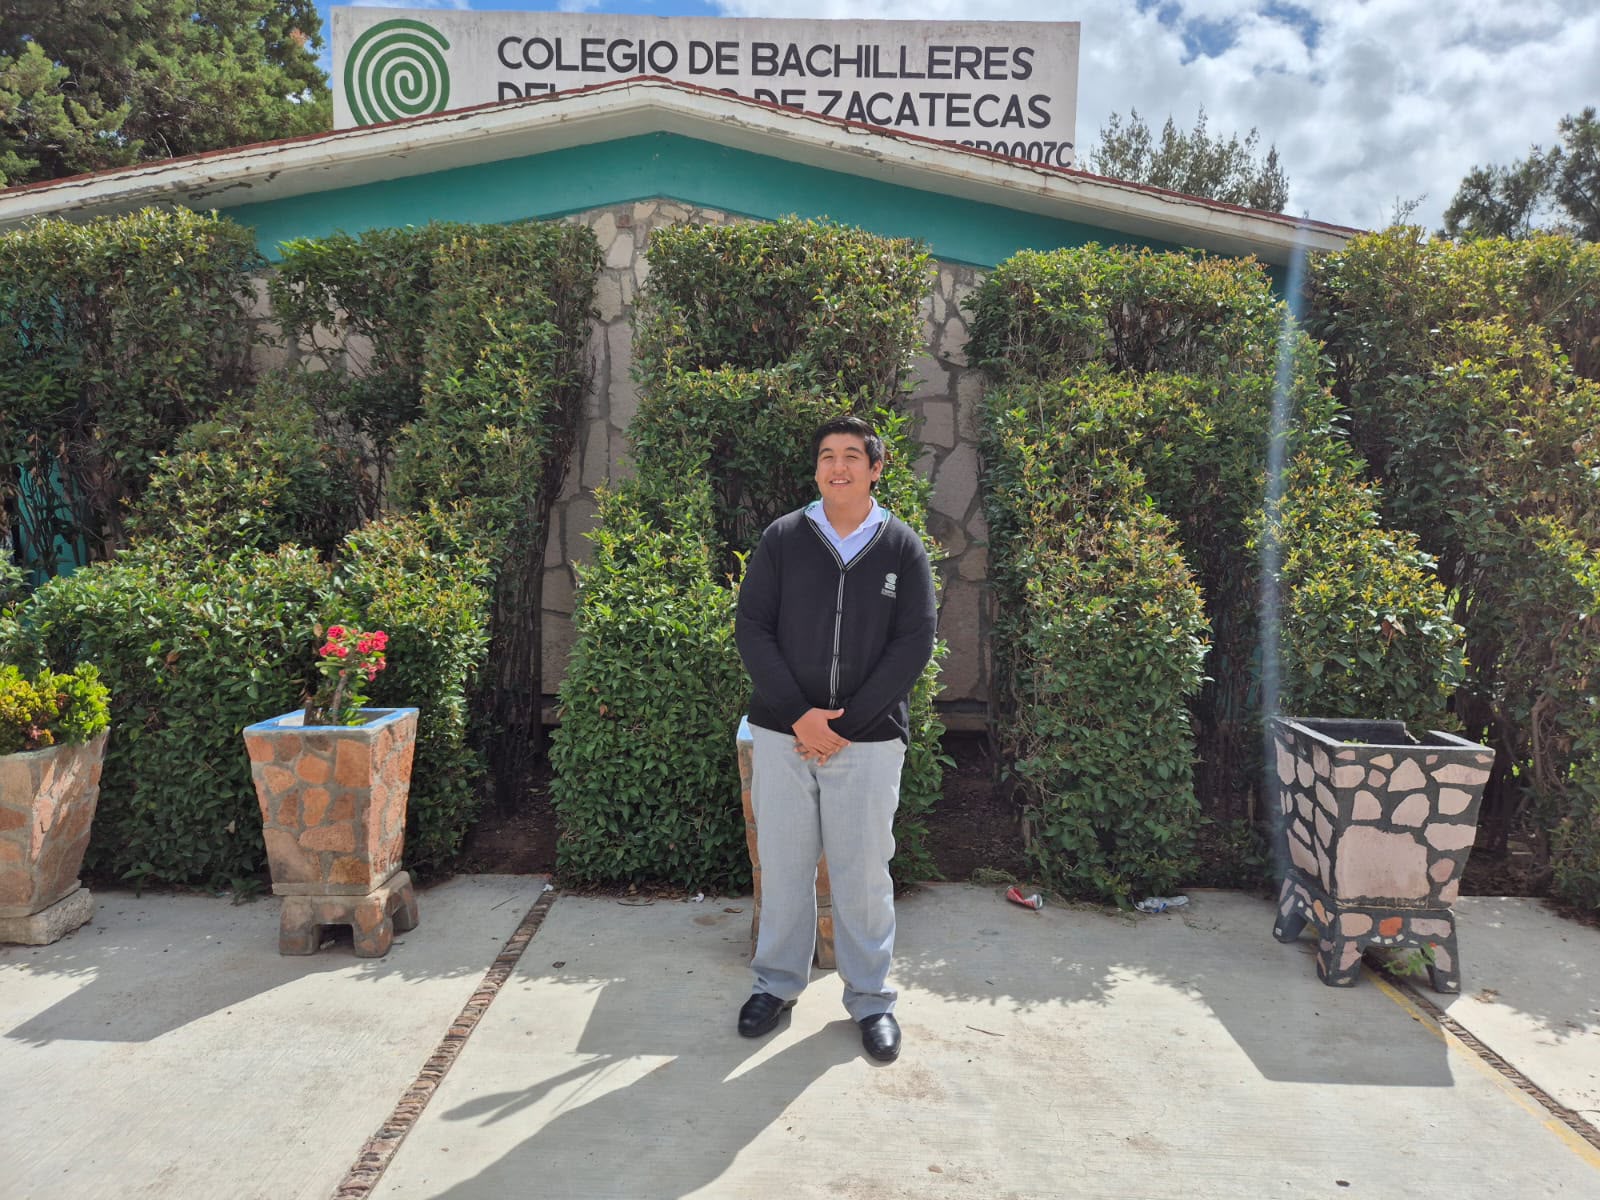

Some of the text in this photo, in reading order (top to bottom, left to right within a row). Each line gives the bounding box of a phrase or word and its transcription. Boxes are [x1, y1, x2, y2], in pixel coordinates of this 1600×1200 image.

[497, 36, 1035, 81] COLEGIO DE BACHILLERES
[818, 90, 1052, 129] ZACATECAS
[943, 139, 1074, 168] 0007C
